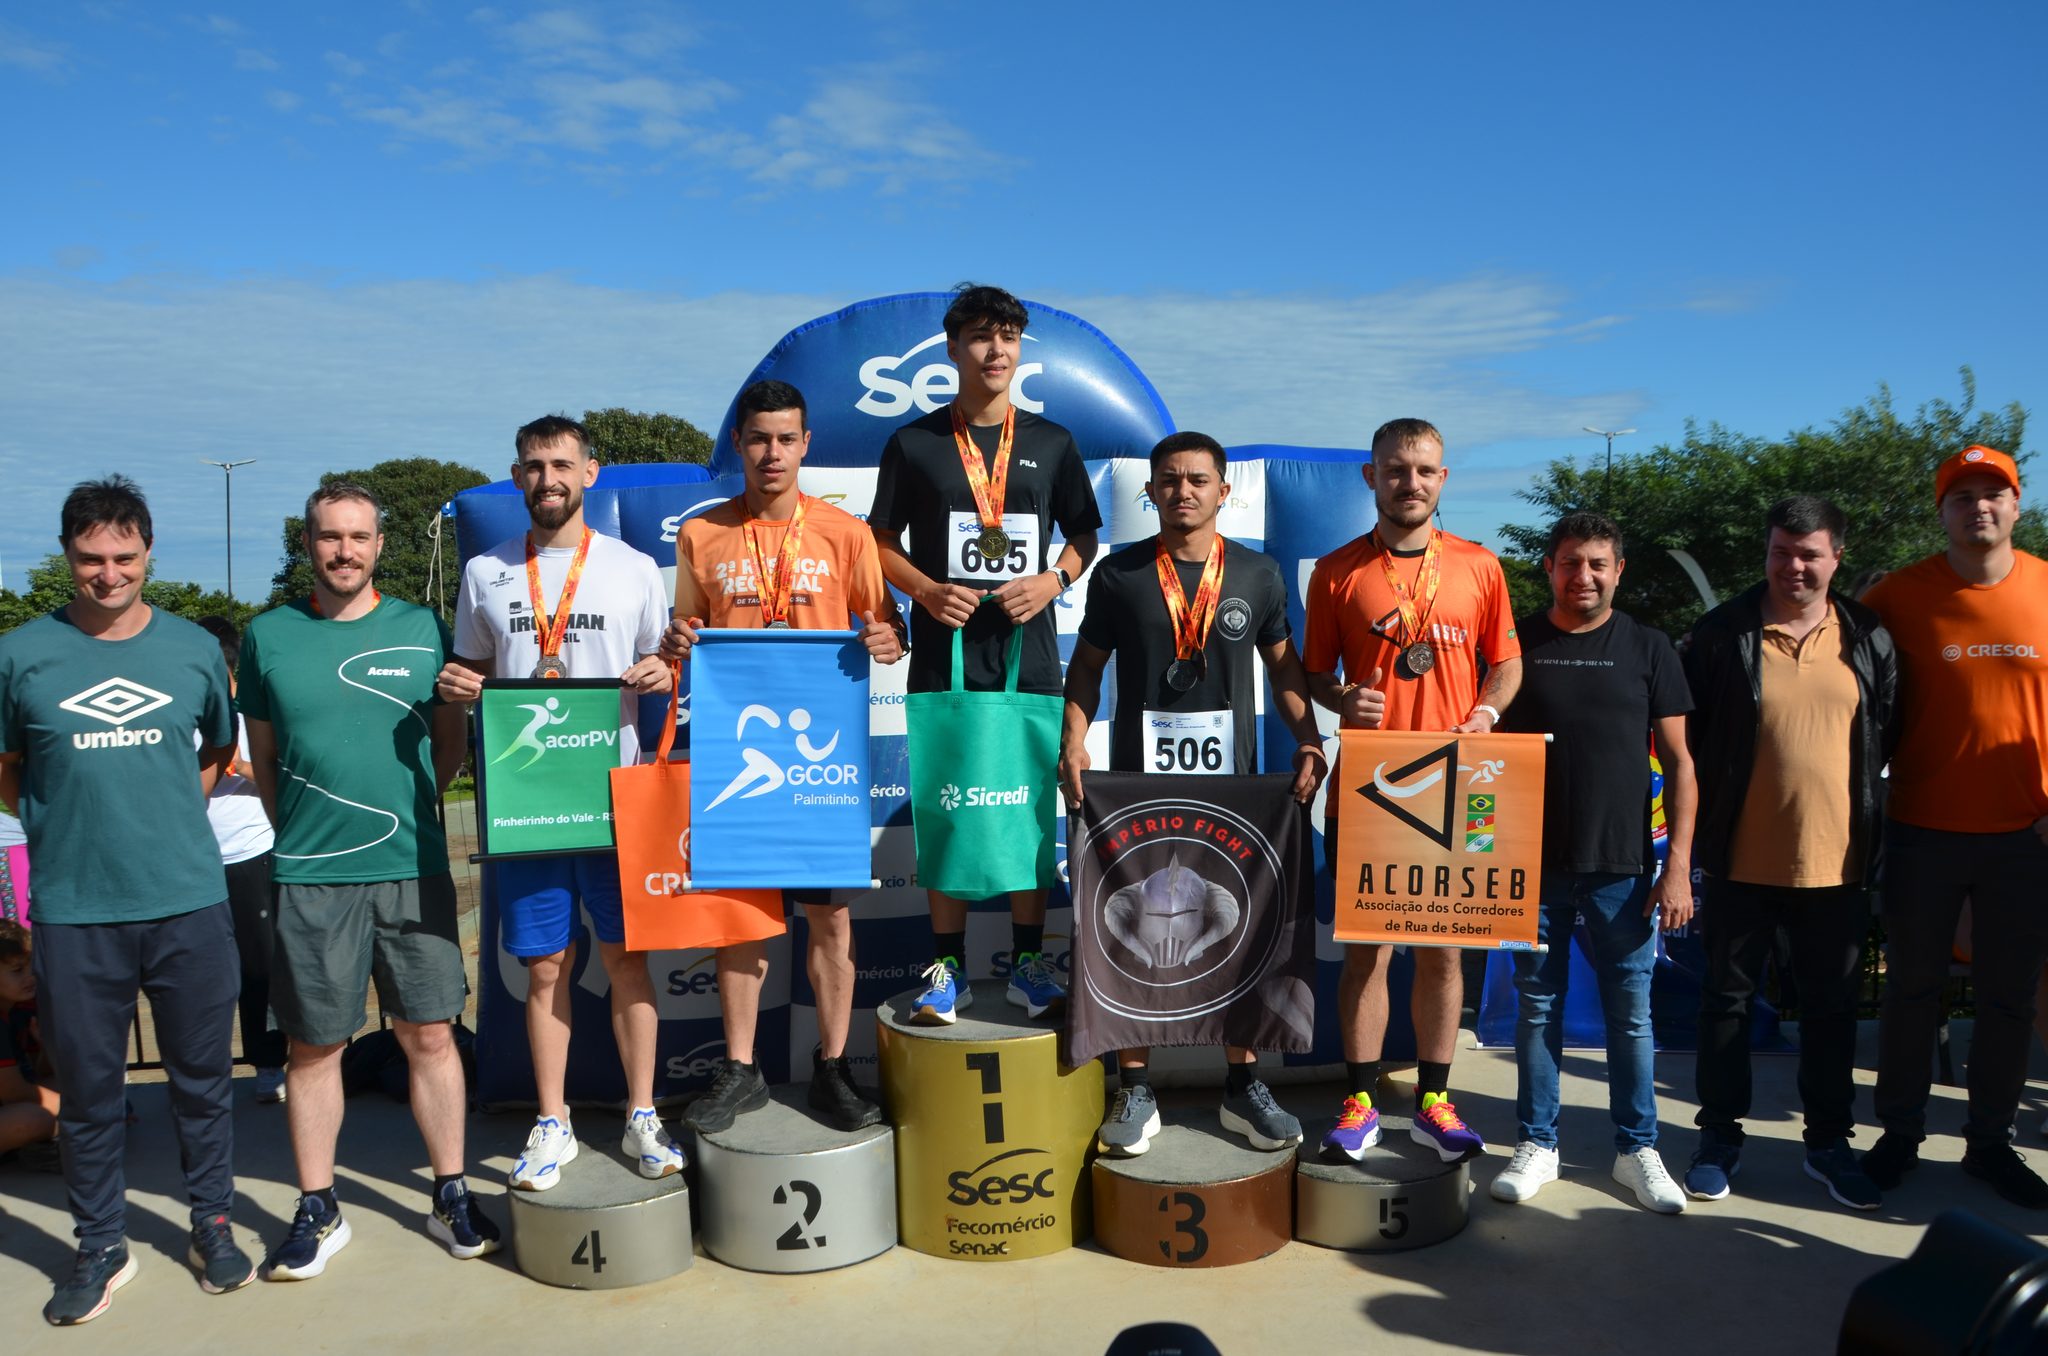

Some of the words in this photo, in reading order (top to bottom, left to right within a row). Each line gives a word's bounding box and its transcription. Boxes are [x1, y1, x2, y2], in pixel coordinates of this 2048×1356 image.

[855, 354, 1044, 417] Sec
[1019, 459, 1038, 468] FILA
[742, 557, 830, 576] RSICA
[723, 574, 822, 595] REGAL
[1967, 644, 2040, 658] CRESOL
[367, 666, 411, 677] Acersic
[1151, 719, 1172, 729] Sesc
[73, 726, 163, 750] umbro
[545, 730, 617, 748] acorPV
[1155, 736, 1222, 771] 506
[786, 764, 859, 786] GCOR
[793, 793, 859, 806] Palmitinho
[965, 785, 1029, 807] Sicredi
[493, 814, 554, 828] Pinheirinho
[556, 813, 570, 825] do
[571, 812, 594, 823] Vale
[1194, 819, 1254, 861] FIGHT
[1358, 863, 1526, 900] ACORSEB
[1355, 899, 1423, 915] Associação
[1427, 902, 1450, 914] dos
[1453, 903, 1524, 917] Corredores
[1385, 920, 1400, 931] de
[1405, 921, 1428, 933] Rua
[1432, 922, 1448, 934] de
[1452, 923, 1492, 935] Seberi
[947, 1168, 1054, 1206] Sesc
[773, 1180, 826, 1250] 2
[947, 1213, 1056, 1236] Fecomércio
[1379, 1197, 1408, 1240] 5
[1159, 1192, 1209, 1263] 3
[571, 1230, 607, 1273] 4
[949, 1240, 1008, 1256] Senac
